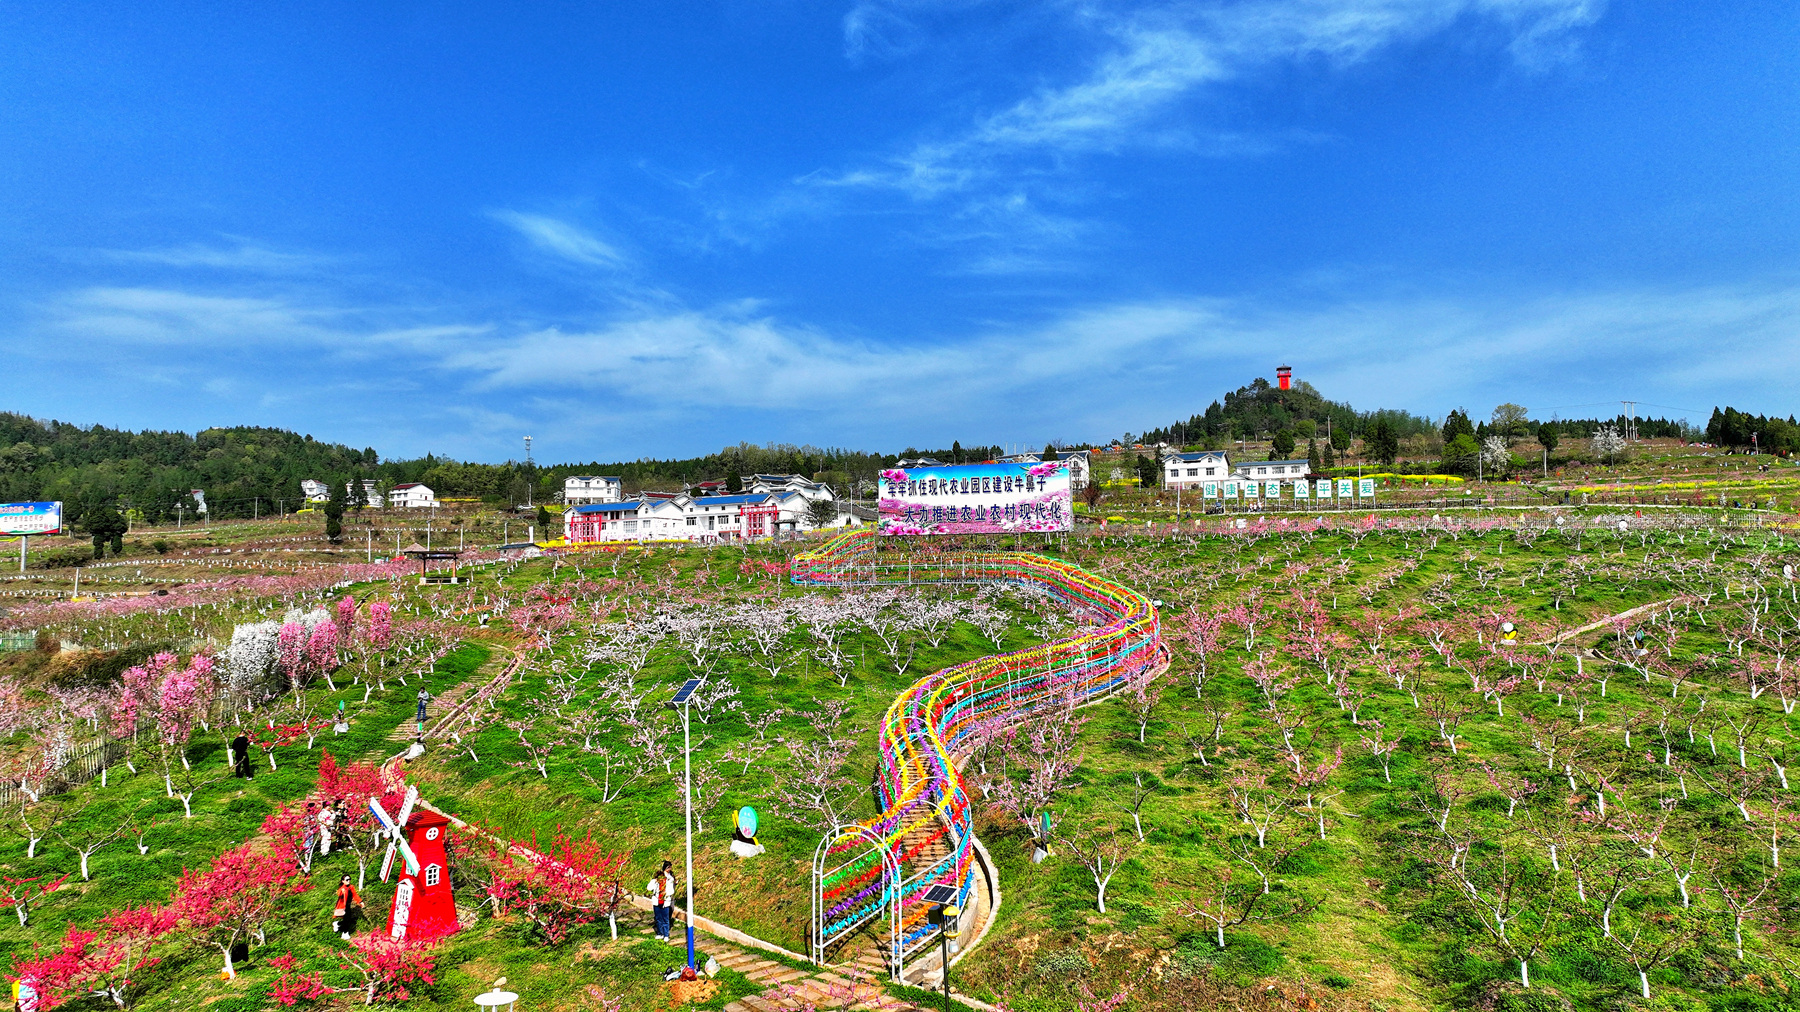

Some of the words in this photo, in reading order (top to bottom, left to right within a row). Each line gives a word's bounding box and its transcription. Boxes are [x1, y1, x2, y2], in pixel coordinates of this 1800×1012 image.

[887, 474, 1047, 497] 牢牢抓住现代农业园区建设牛鼻子
[1205, 483, 1279, 496] 健康生态
[1296, 482, 1373, 495] 公平关爱
[904, 501, 1062, 523] 大力推进农业农村现代化
